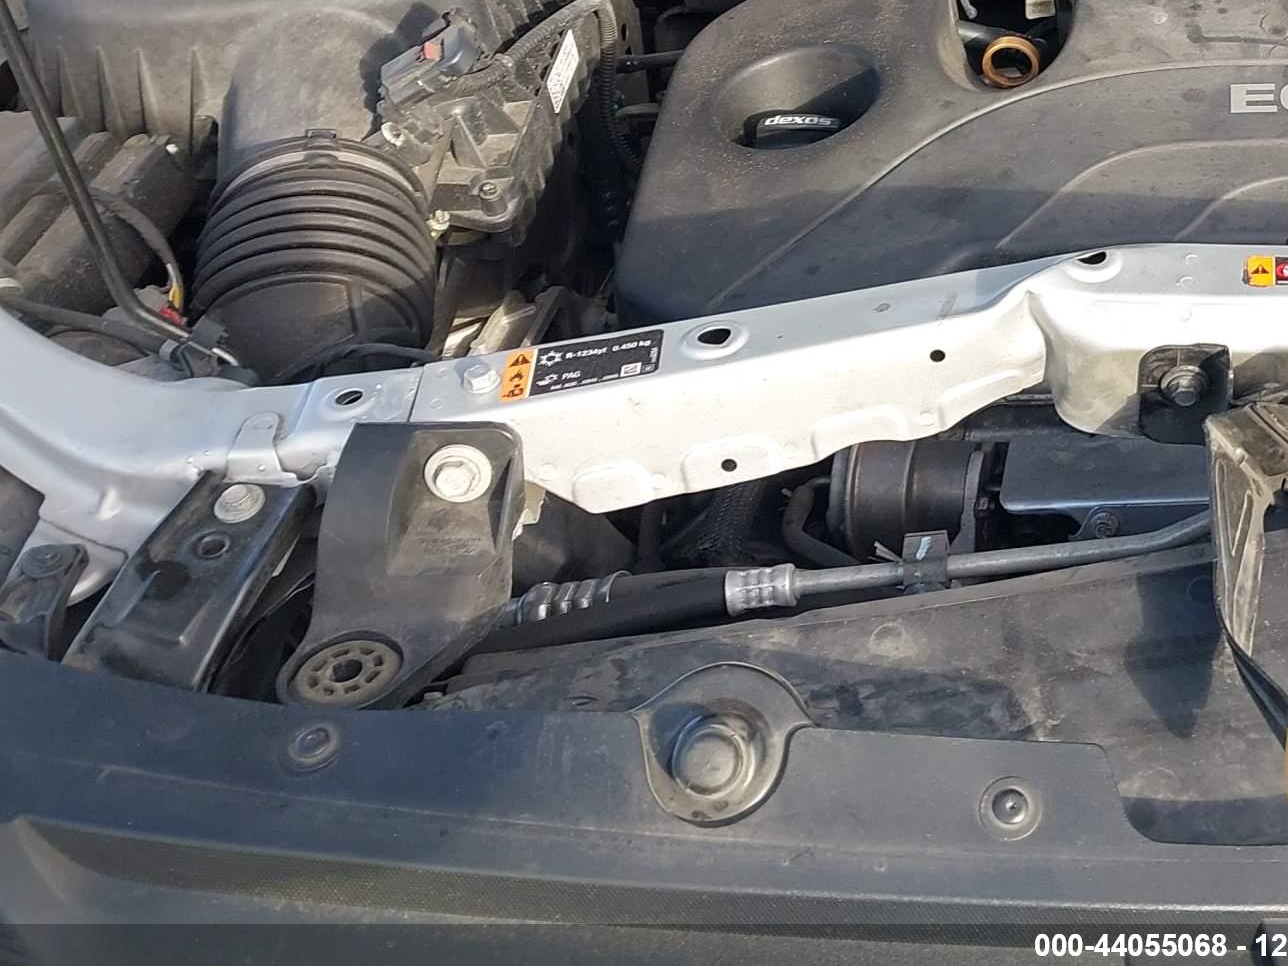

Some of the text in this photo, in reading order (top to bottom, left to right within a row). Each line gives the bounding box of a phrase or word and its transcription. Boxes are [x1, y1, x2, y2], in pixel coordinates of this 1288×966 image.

[764, 115, 832, 126] dexos
[565, 347, 608, 360] R-1234yf
[638, 339, 652, 348] kg
[561, 370, 581, 381] PAG
